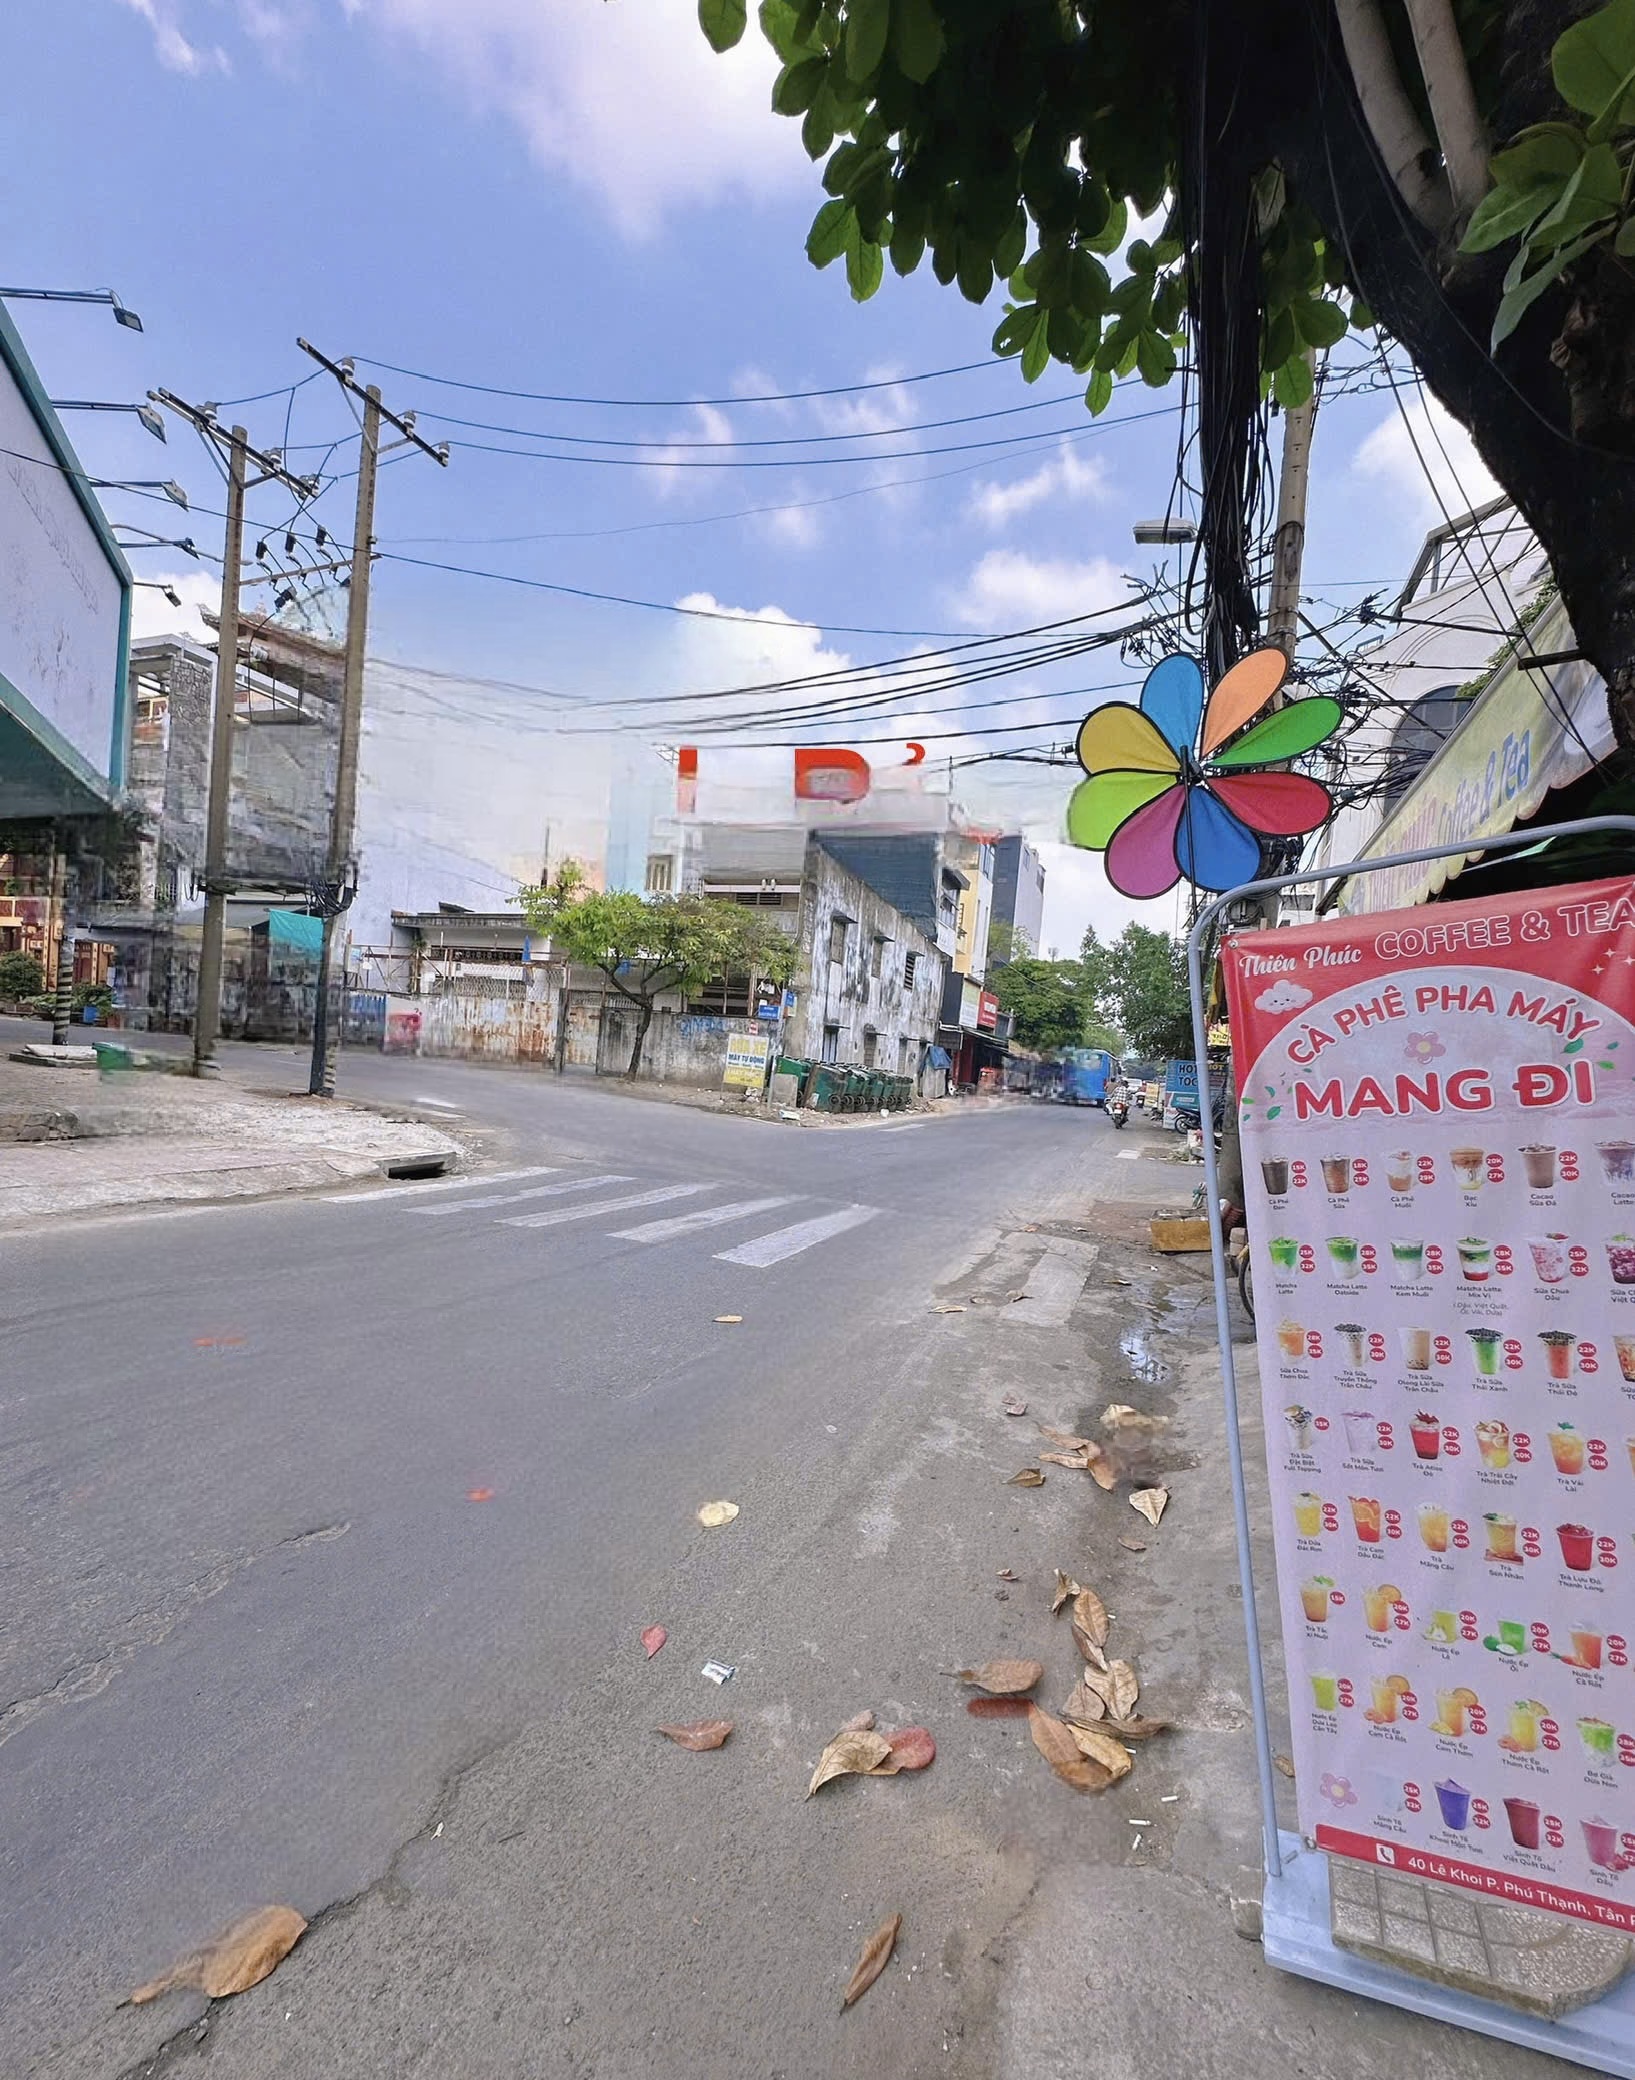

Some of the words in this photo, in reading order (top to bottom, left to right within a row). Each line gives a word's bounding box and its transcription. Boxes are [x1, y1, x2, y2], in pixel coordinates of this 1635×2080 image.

[1498, 729, 1532, 806] Tea
[1239, 954, 1297, 978] Thiên
[1303, 945, 1362, 969] Phúc
[1375, 915, 1510, 960] COFFEE
[1520, 910, 1551, 942] &
[1558, 898, 1635, 936] TEA
[1287, 1024, 1336, 1064] CÀ
[1333, 984, 1407, 1036] PHÊ
[1415, 985, 1496, 1013] PHA
[1507, 991, 1600, 1041] MÁY
[1294, 1068, 1493, 1120] MANG
[1511, 1059, 1595, 1109] ĐI
[1408, 1857, 1426, 1870] 40
[1430, 1862, 1447, 1876] Lê
[1450, 1868, 1482, 1886] Khoi
[1486, 1877, 1500, 1890] P.
[1504, 1882, 1533, 1899] Phú
[1537, 1890, 1592, 1916] Thạnh,
[1594, 1905, 1626, 1925] Tân
